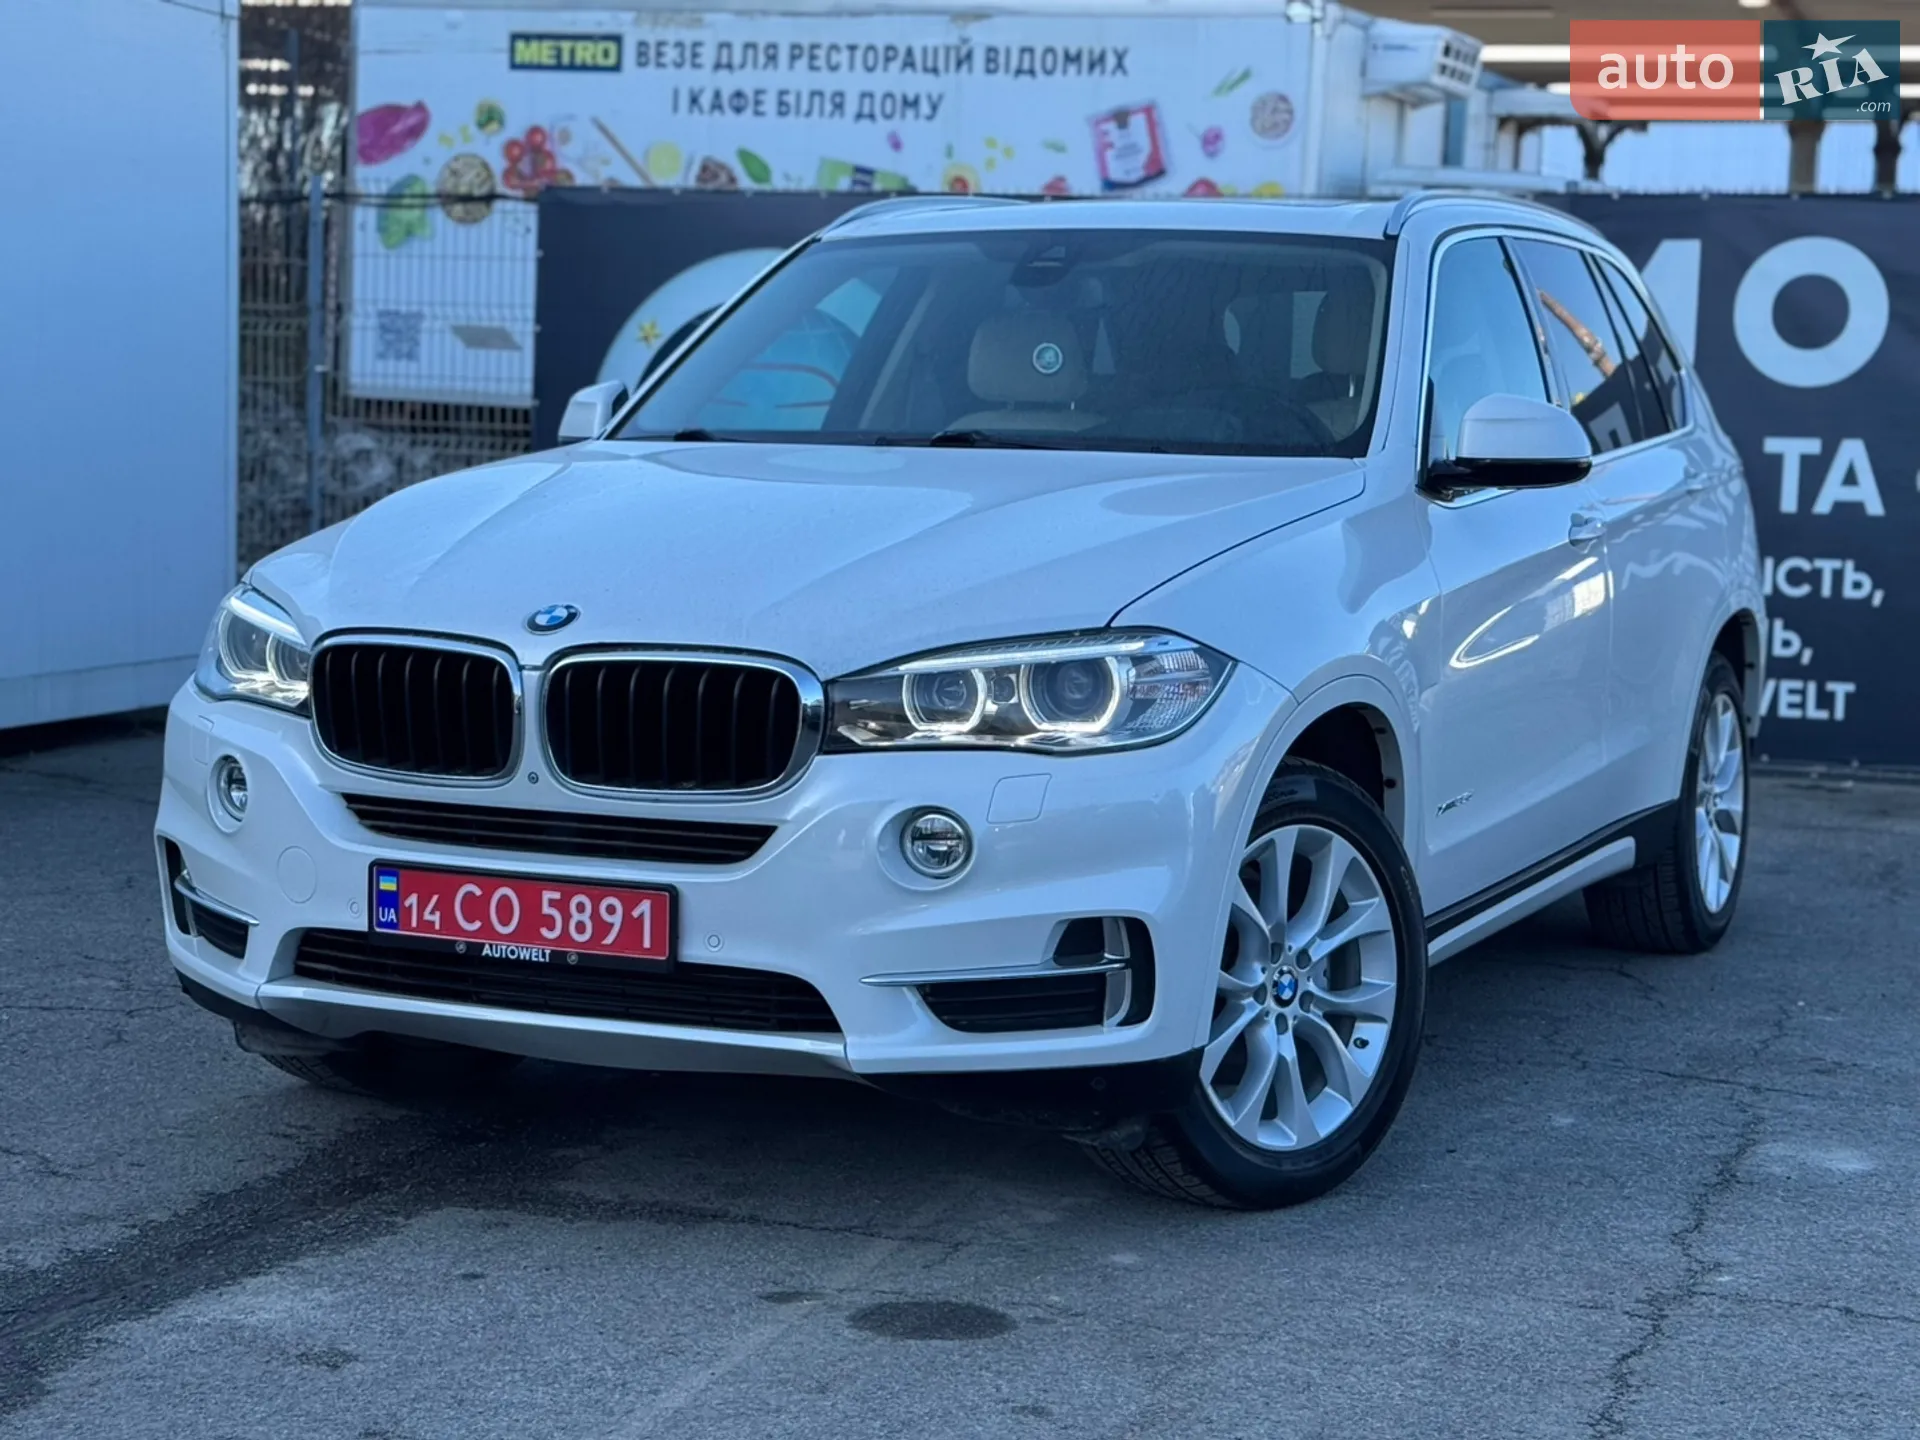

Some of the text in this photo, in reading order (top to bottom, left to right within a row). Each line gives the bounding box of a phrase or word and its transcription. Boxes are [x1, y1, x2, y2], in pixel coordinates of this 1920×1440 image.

[513, 38, 619, 68] METRO
[635, 36, 1129, 79] ВЕЗЕ ДЛЯ РЕСТОРАЦІЙ ВІДОМИХ
[688, 88, 767, 117] КАФЕ
[776, 89, 845, 118] БІЛЯ
[854, 91, 944, 123] ДОМУ
[1763, 437, 1886, 516] ТА
[378, 906, 397, 924] UA
[403, 882, 653, 949] 14 CO 5891
[481, 942, 552, 963] AUTOWELT
